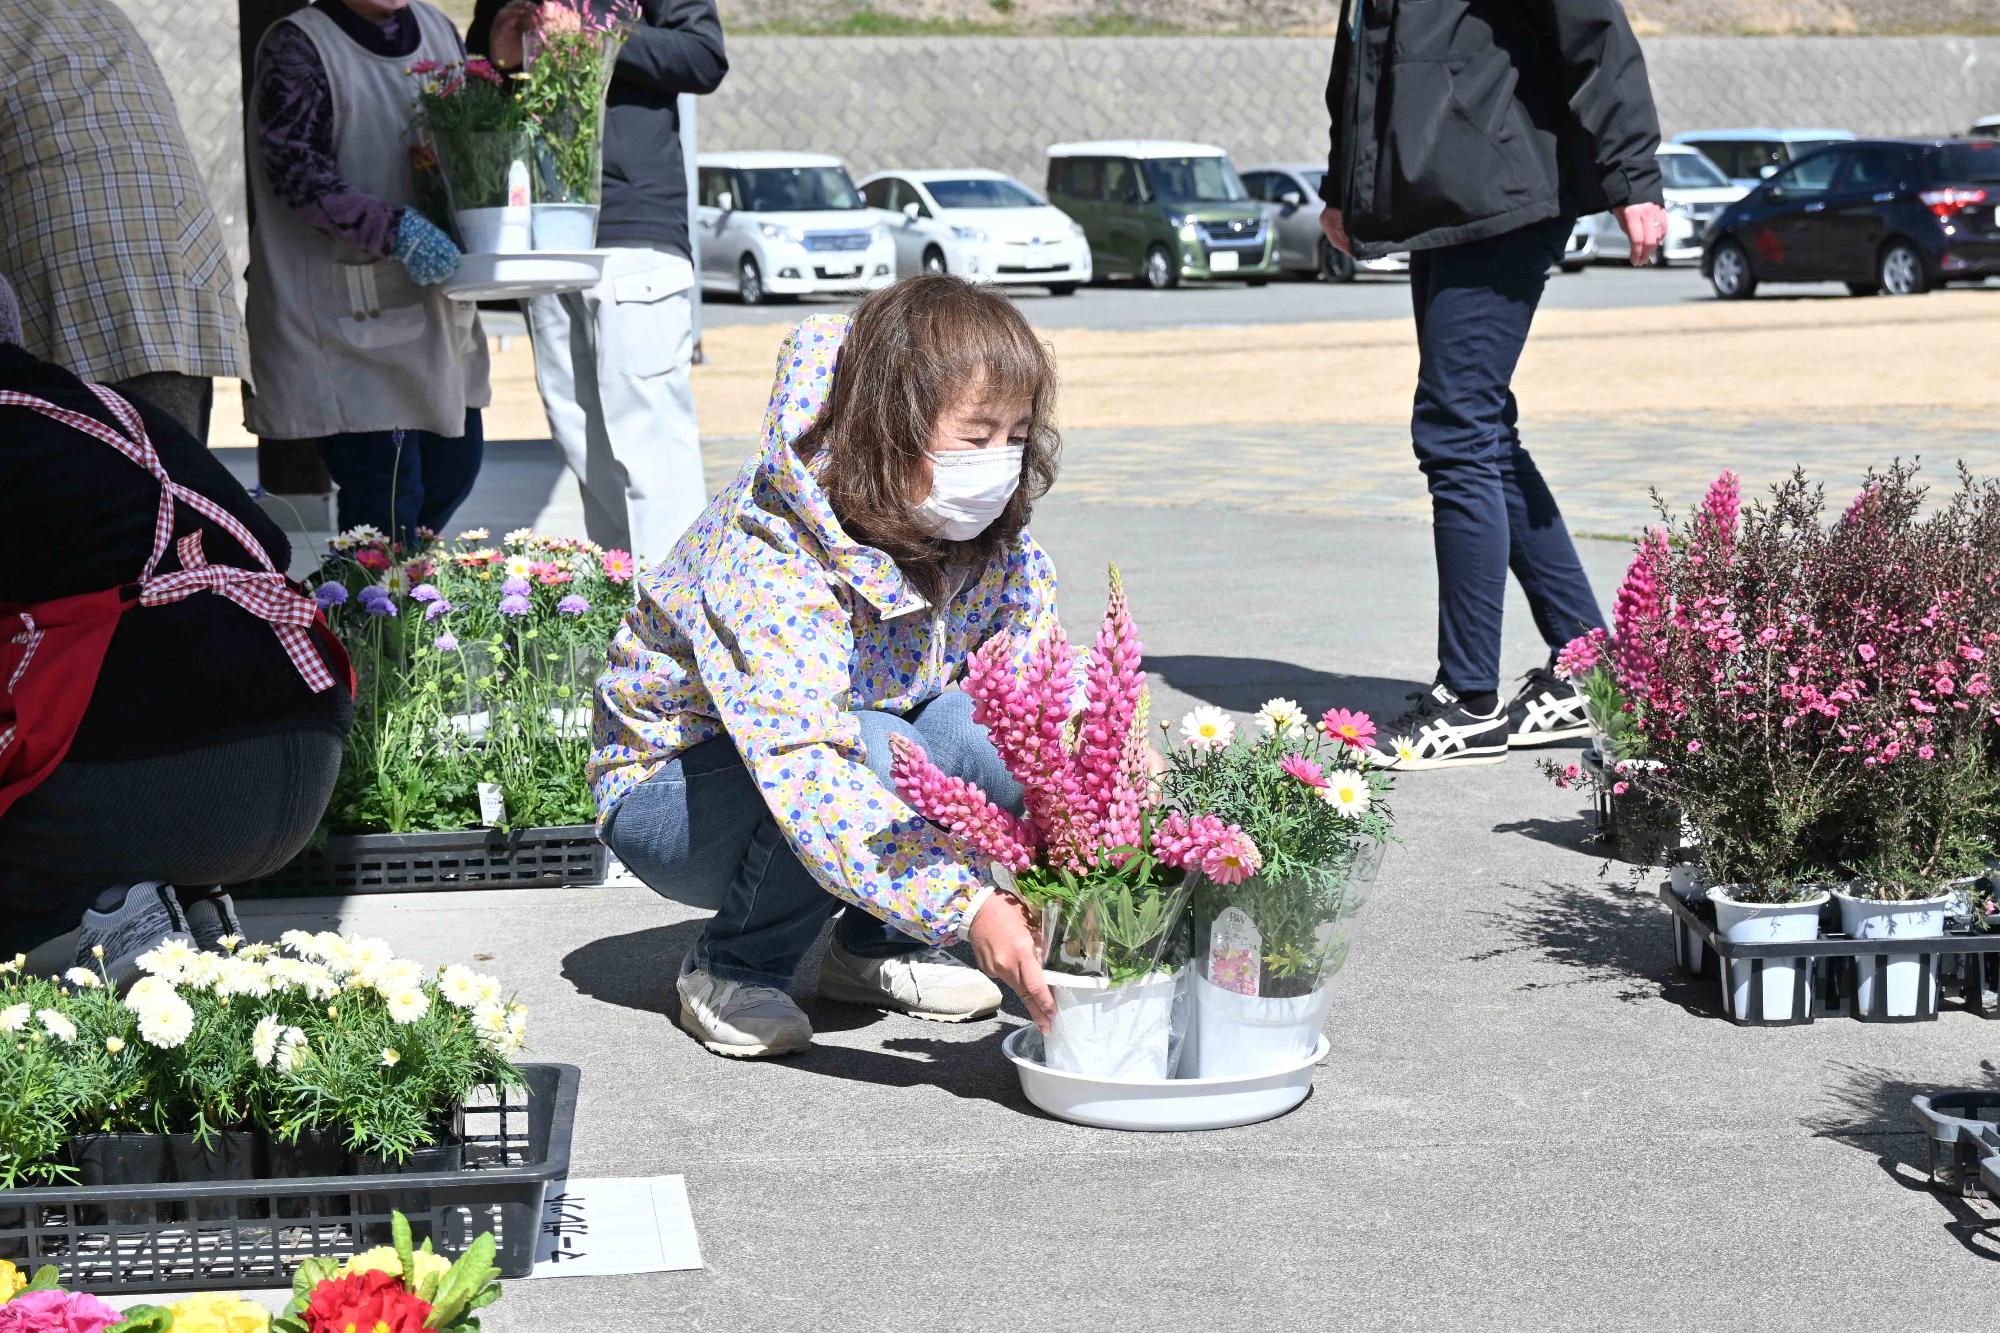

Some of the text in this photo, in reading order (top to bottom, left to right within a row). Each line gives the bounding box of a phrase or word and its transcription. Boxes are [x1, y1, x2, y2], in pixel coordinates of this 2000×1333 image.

[541, 1193, 588, 1263] マーガレット
